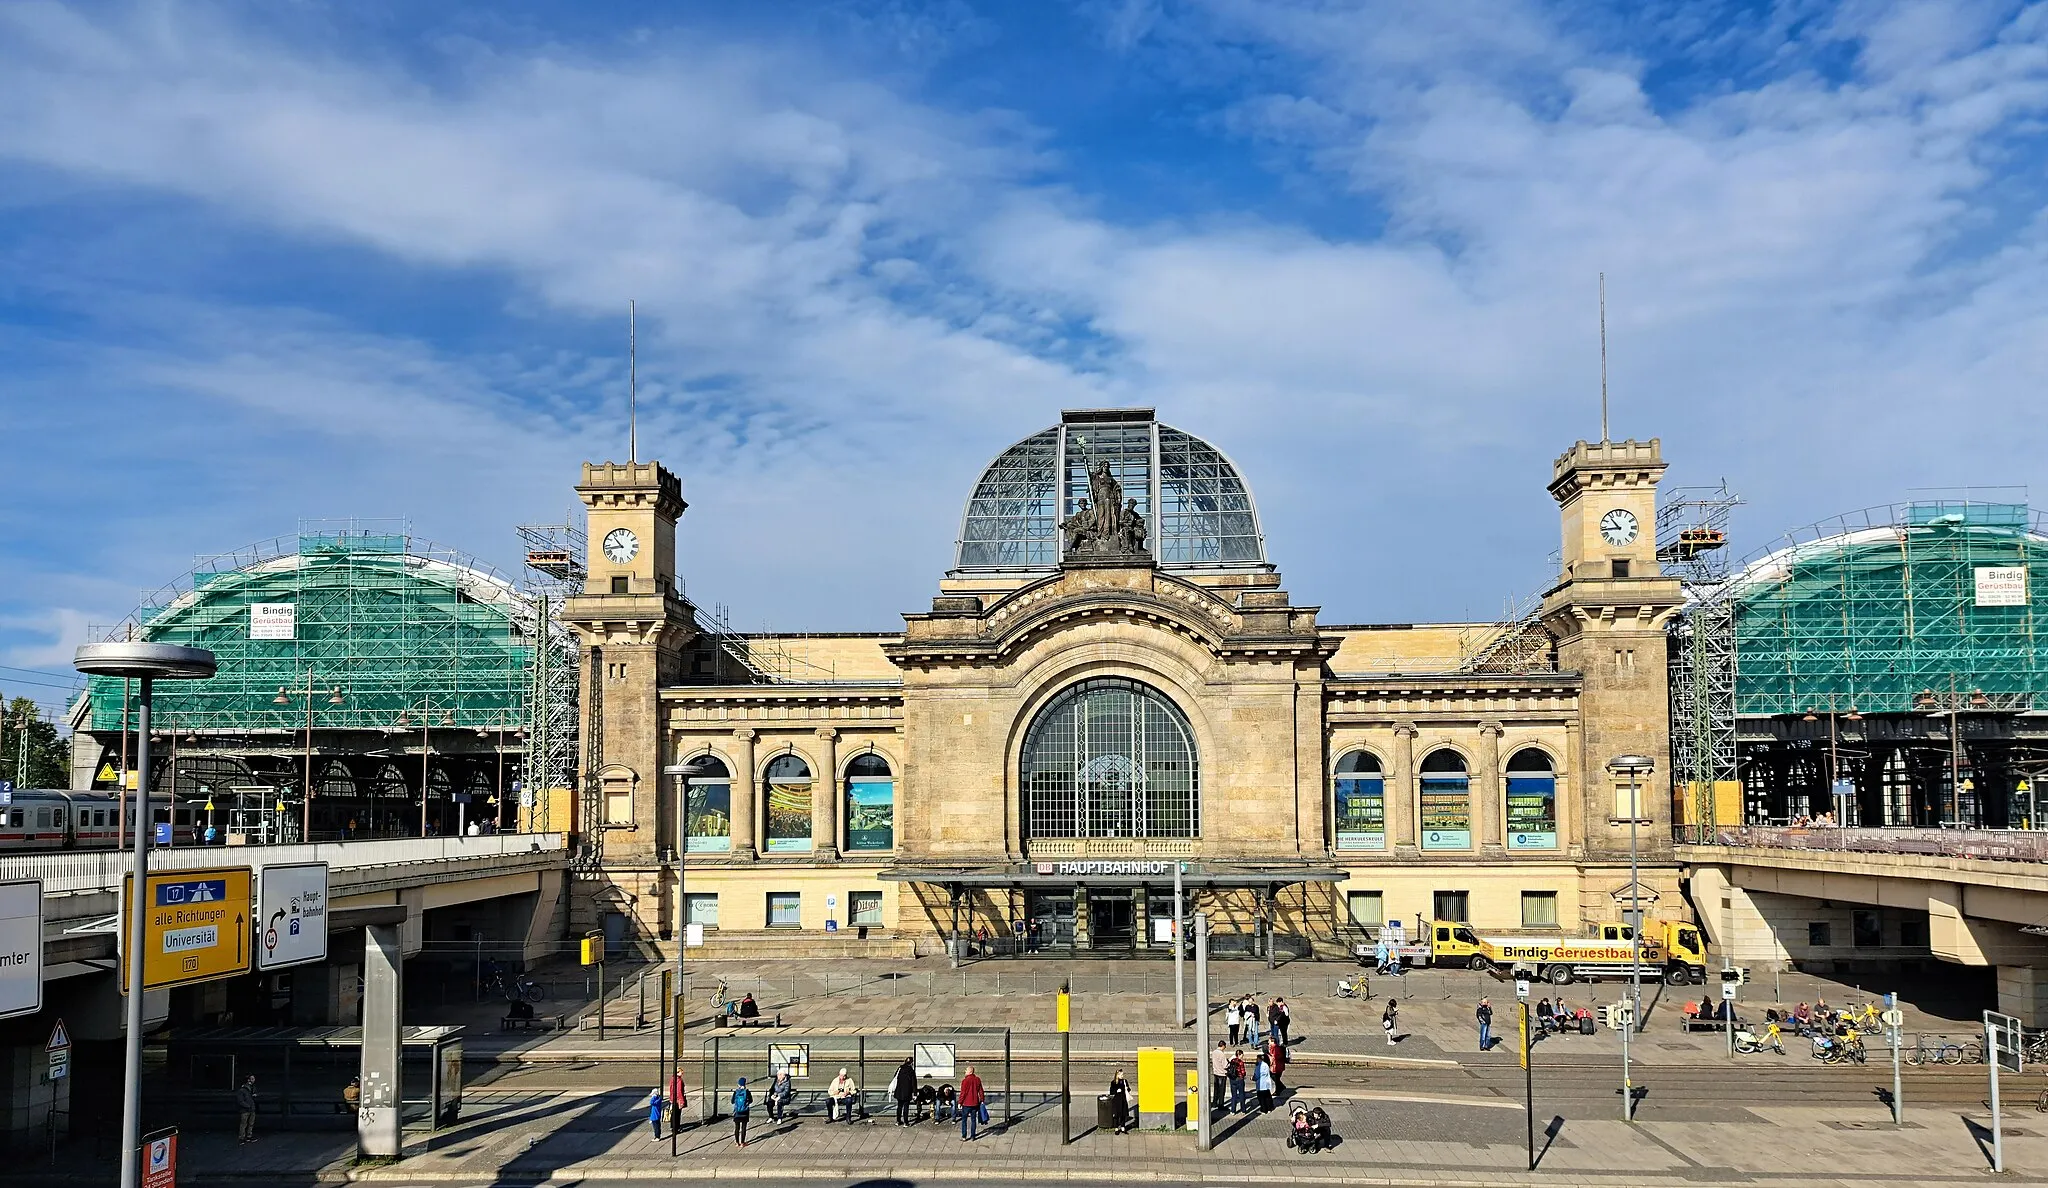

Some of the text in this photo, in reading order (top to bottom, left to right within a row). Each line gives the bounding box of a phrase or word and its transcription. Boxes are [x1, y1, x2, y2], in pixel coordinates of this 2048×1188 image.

[1989, 571, 2023, 581] Bindig
[1977, 582, 2023, 590] Gerüstbau
[262, 606, 293, 616] Bindig
[252, 617, 293, 625] Gerüstbau
[3, 781, 11, 791] 2
[512, 781, 519, 789] F
[3, 793, 11, 803] E
[1039, 863, 1051, 871] DB
[1059, 861, 1169, 874] HAUPTBAHNHOF
[171, 888, 180, 900] 17
[303, 890, 321, 904] Haupt-
[852, 898, 879, 911] Ditsch
[155, 909, 226, 925] alle Richtungen
[303, 904, 324, 918] bahnhof
[165, 930, 216, 948] Universität
[185, 958, 197, 970] 170
